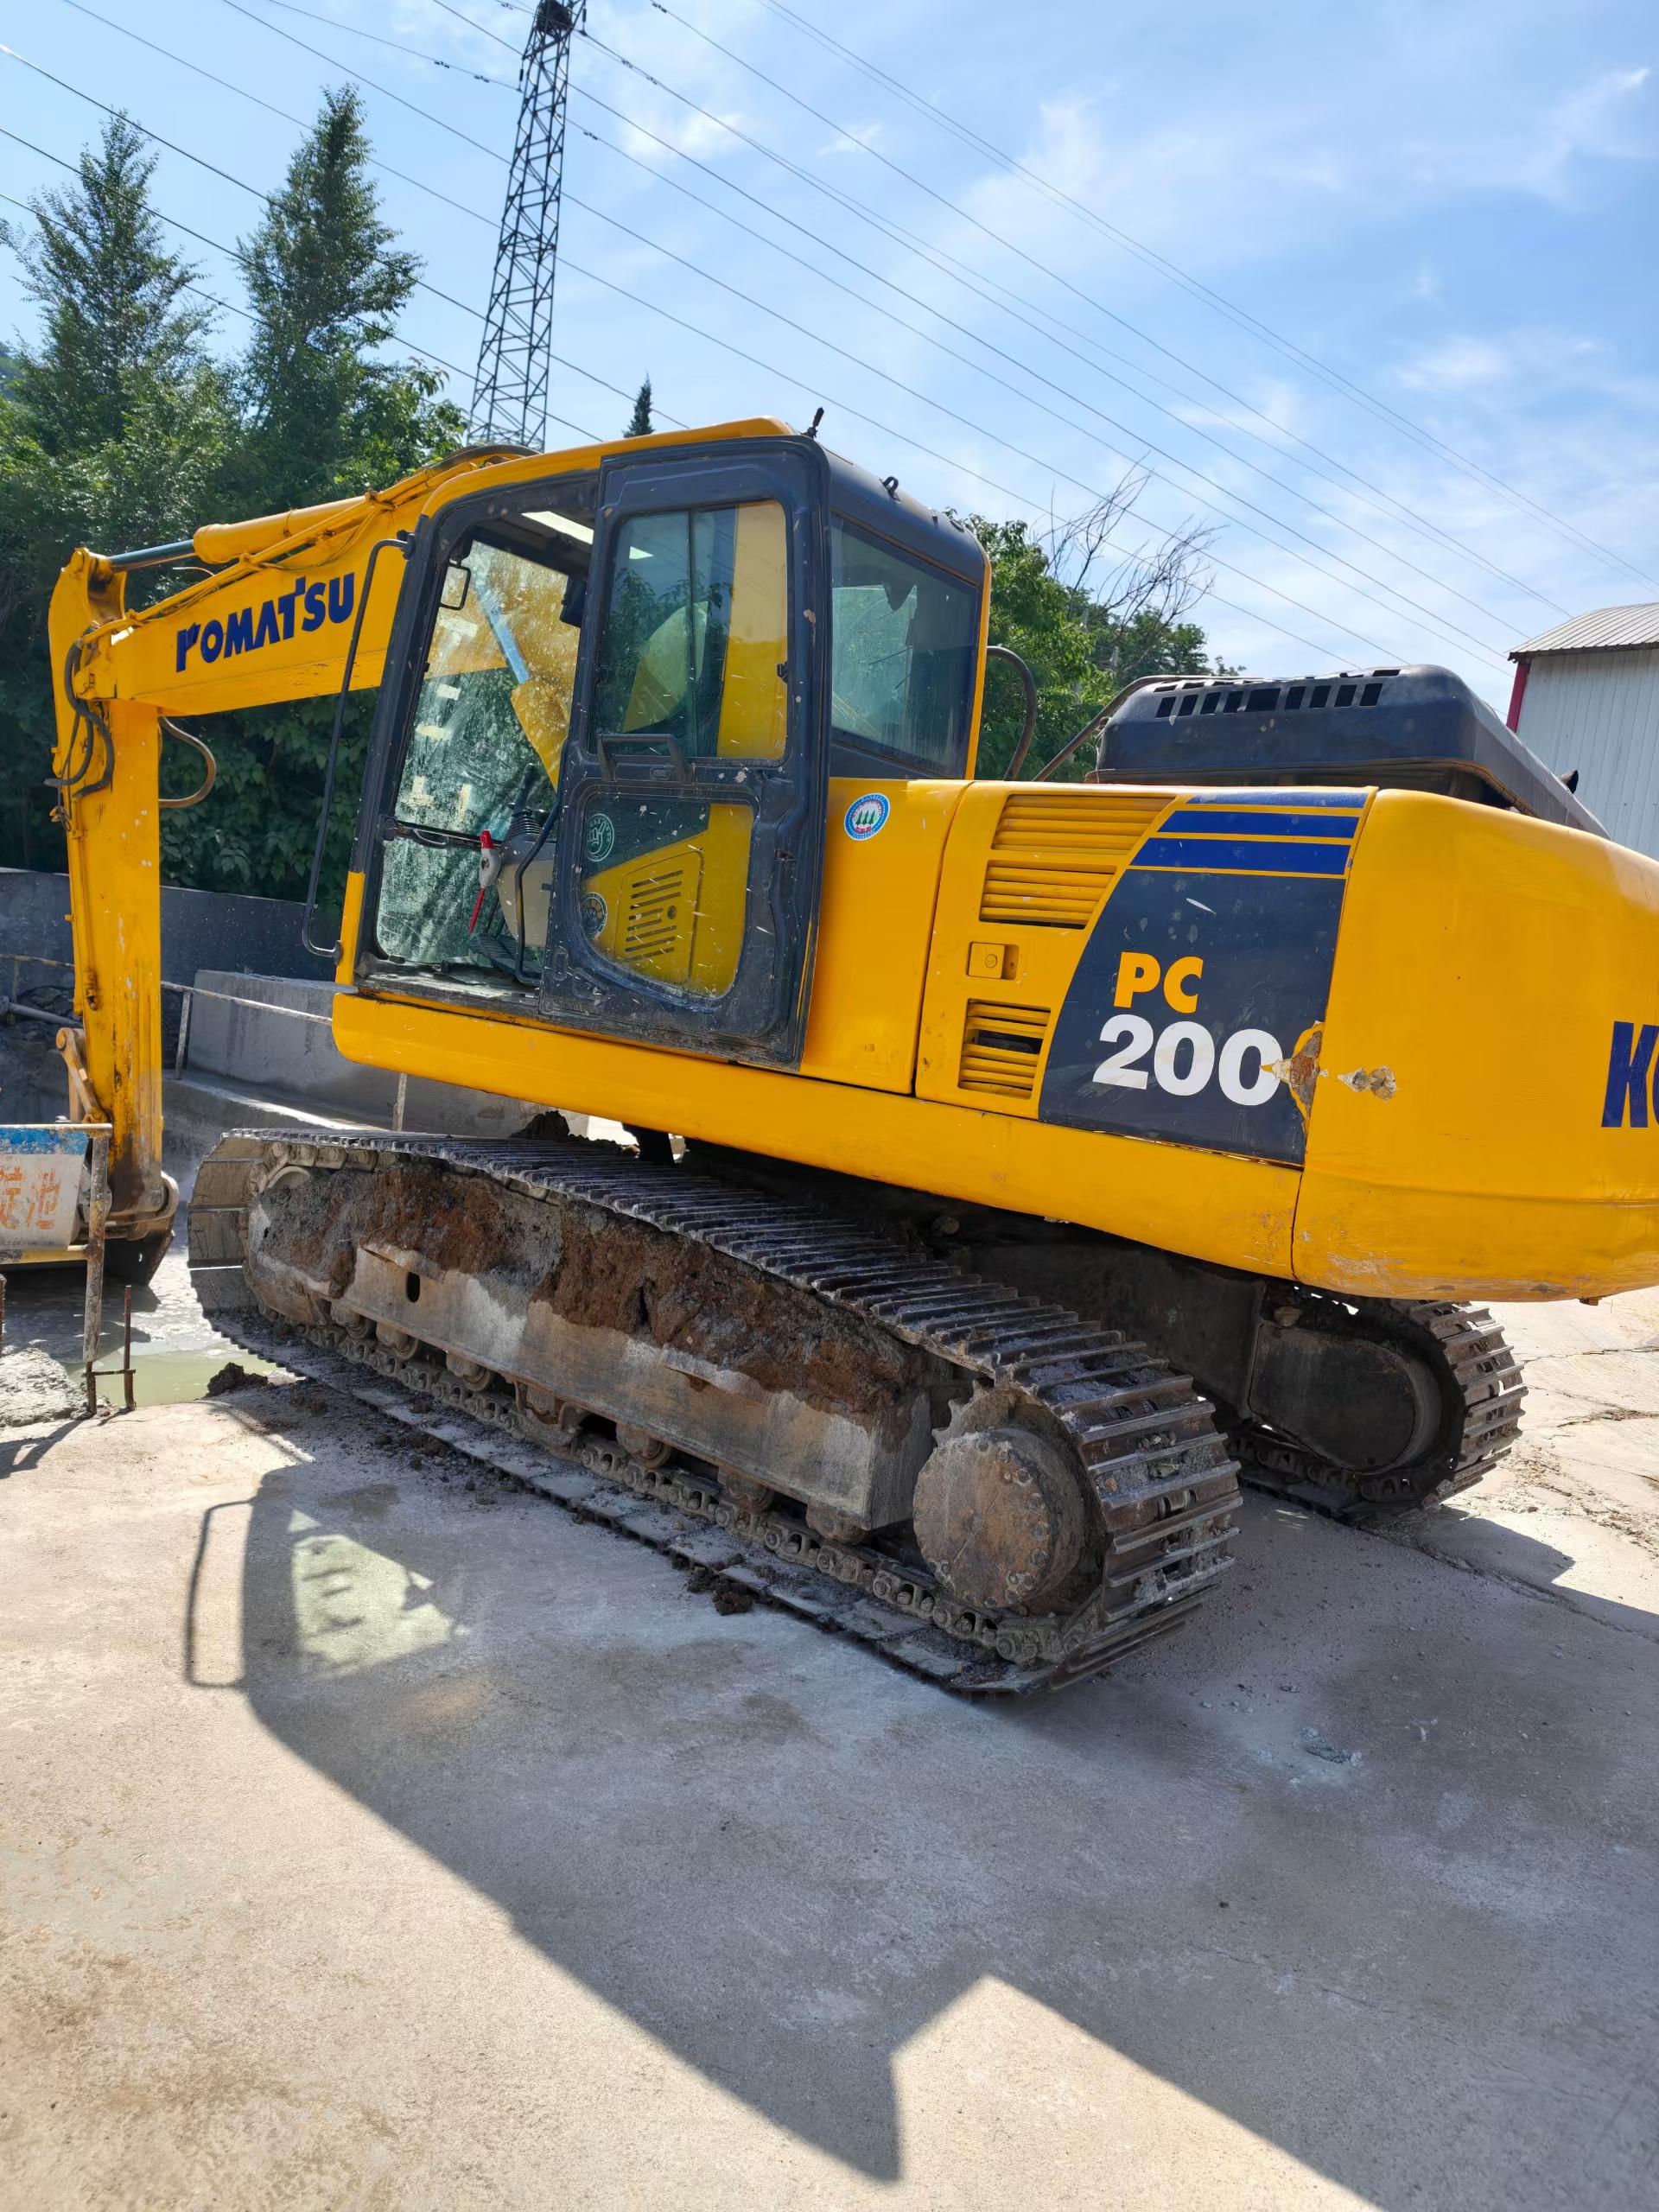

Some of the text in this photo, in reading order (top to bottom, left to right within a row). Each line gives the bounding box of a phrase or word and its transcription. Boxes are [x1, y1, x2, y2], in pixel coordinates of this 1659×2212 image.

[1114, 951, 1204, 1014] PC
[1092, 1014, 1283, 1106] 200
[1601, 1020, 1659, 1128] K
